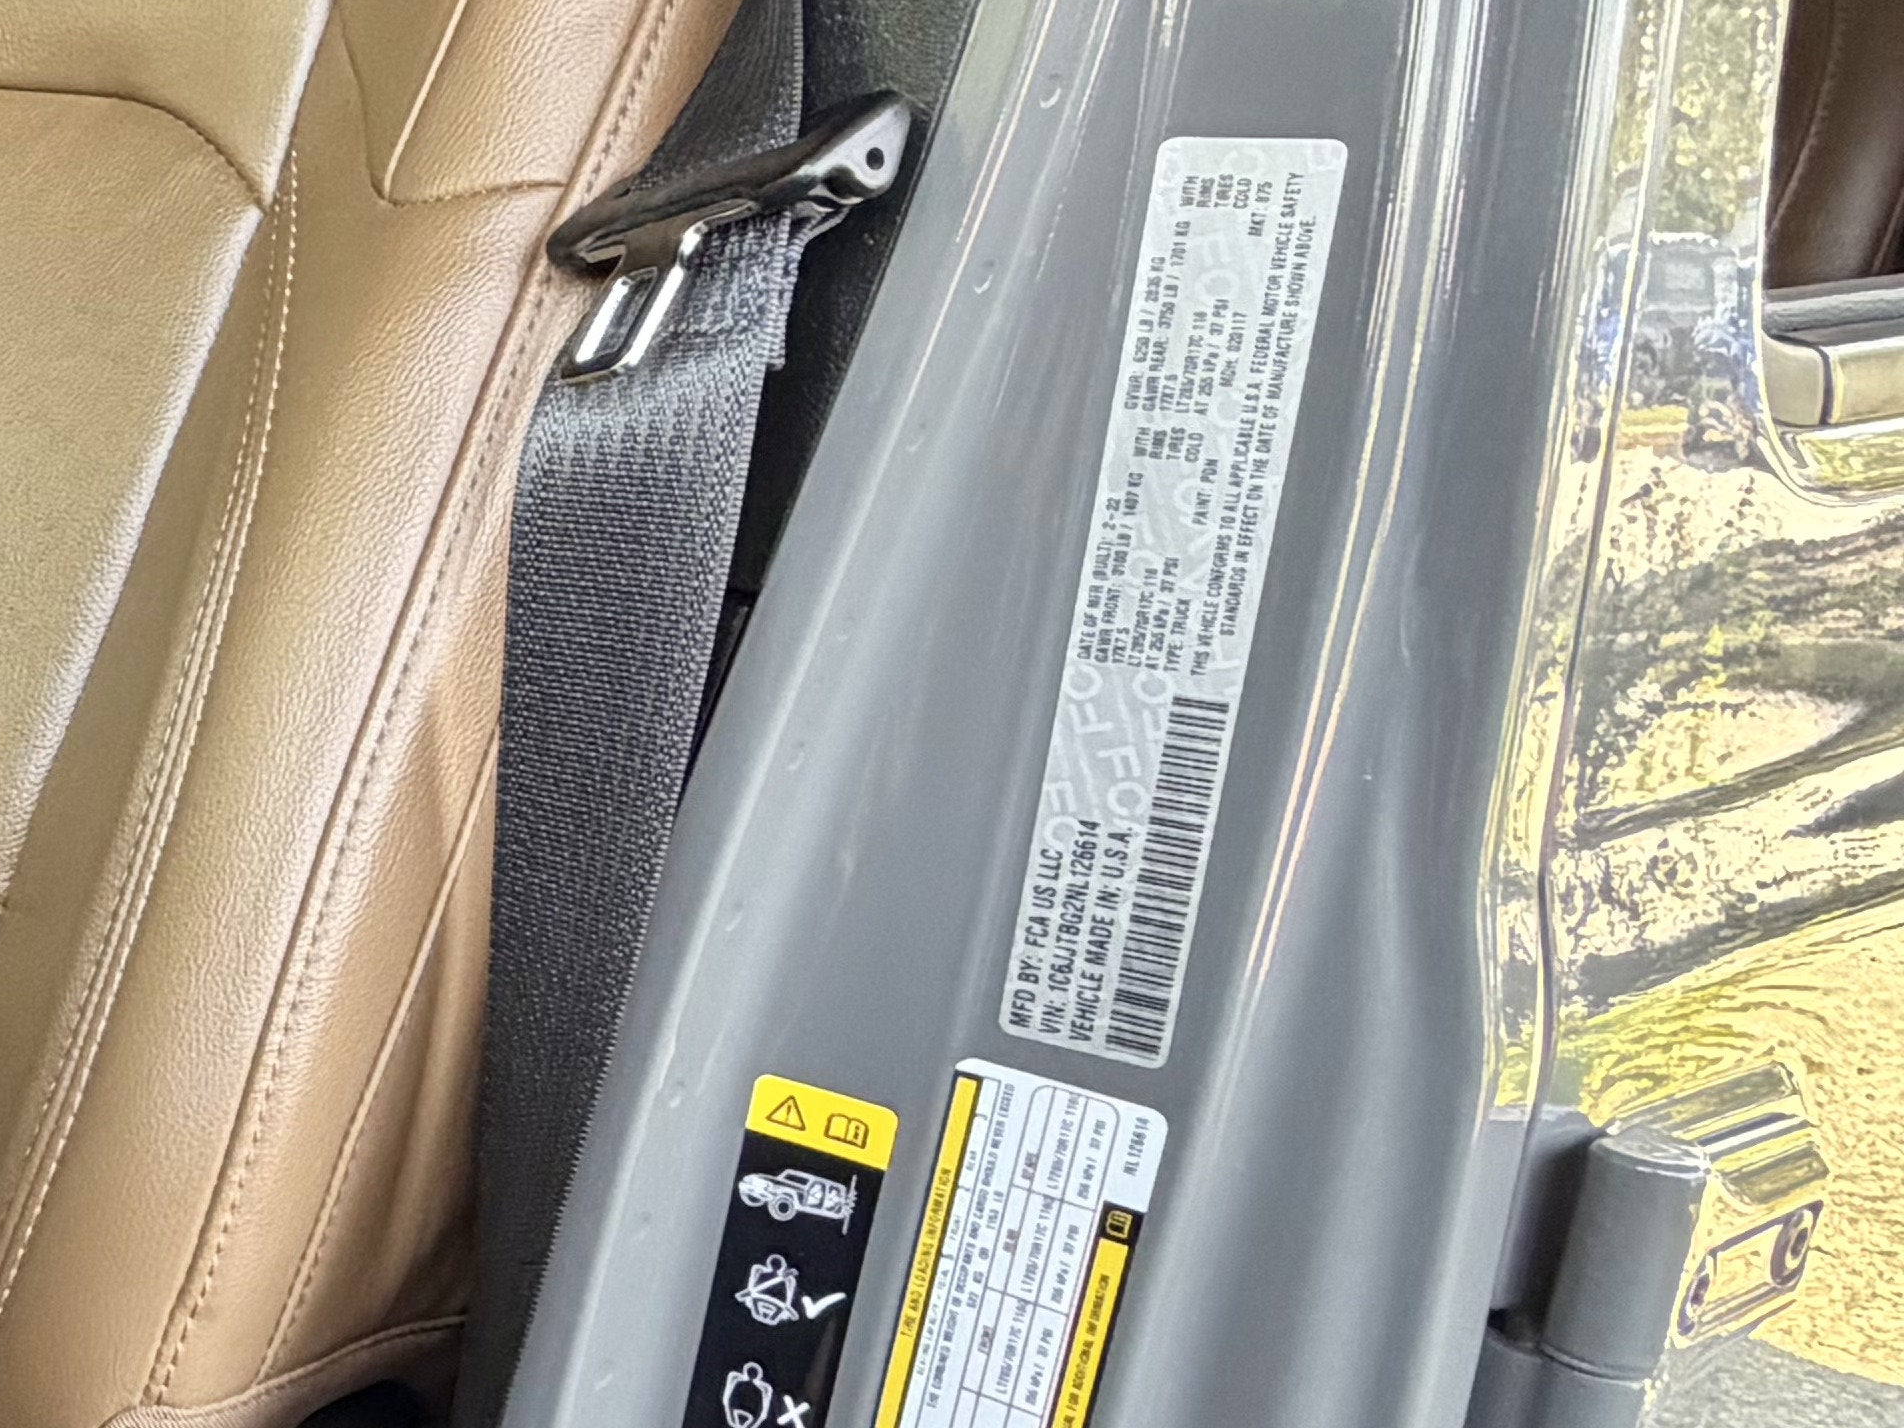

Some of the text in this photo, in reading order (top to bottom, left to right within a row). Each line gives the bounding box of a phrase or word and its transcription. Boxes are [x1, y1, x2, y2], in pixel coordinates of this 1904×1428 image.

[1279, 173, 1303, 216] SAFETY
[1269, 223, 1293, 269] VEHICLE
[1260, 275, 1283, 314] MOTOR
[1249, 321, 1274, 372] FEDERAL
[1219, 216, 1316, 635] STANDARDS IN EFFECT ON THE DATE OF MANUFACTURE SHOWN ABOVE.
[1227, 419, 1254, 486] APPLICABLE
[1101, 498, 1120, 529] 2-22
[1222, 492, 1240, 511] ALL
[1219, 516, 1235, 529] TO
[1206, 535, 1232, 597] CONFORMS
[1086, 585, 1103, 607] MFR
[1082, 613, 1097, 626] OF
[1196, 601, 1219, 645] VEHICLE
[1077, 631, 1094, 658] DATE
[1190, 651, 1209, 675] THIS
[1009, 849, 1062, 1027] MFD BY: FCA US LLC
[1069, 824, 1131, 1042] VEHICLE MADE IN: U.S.A.
[1039, 999, 1066, 1035] VIN:
